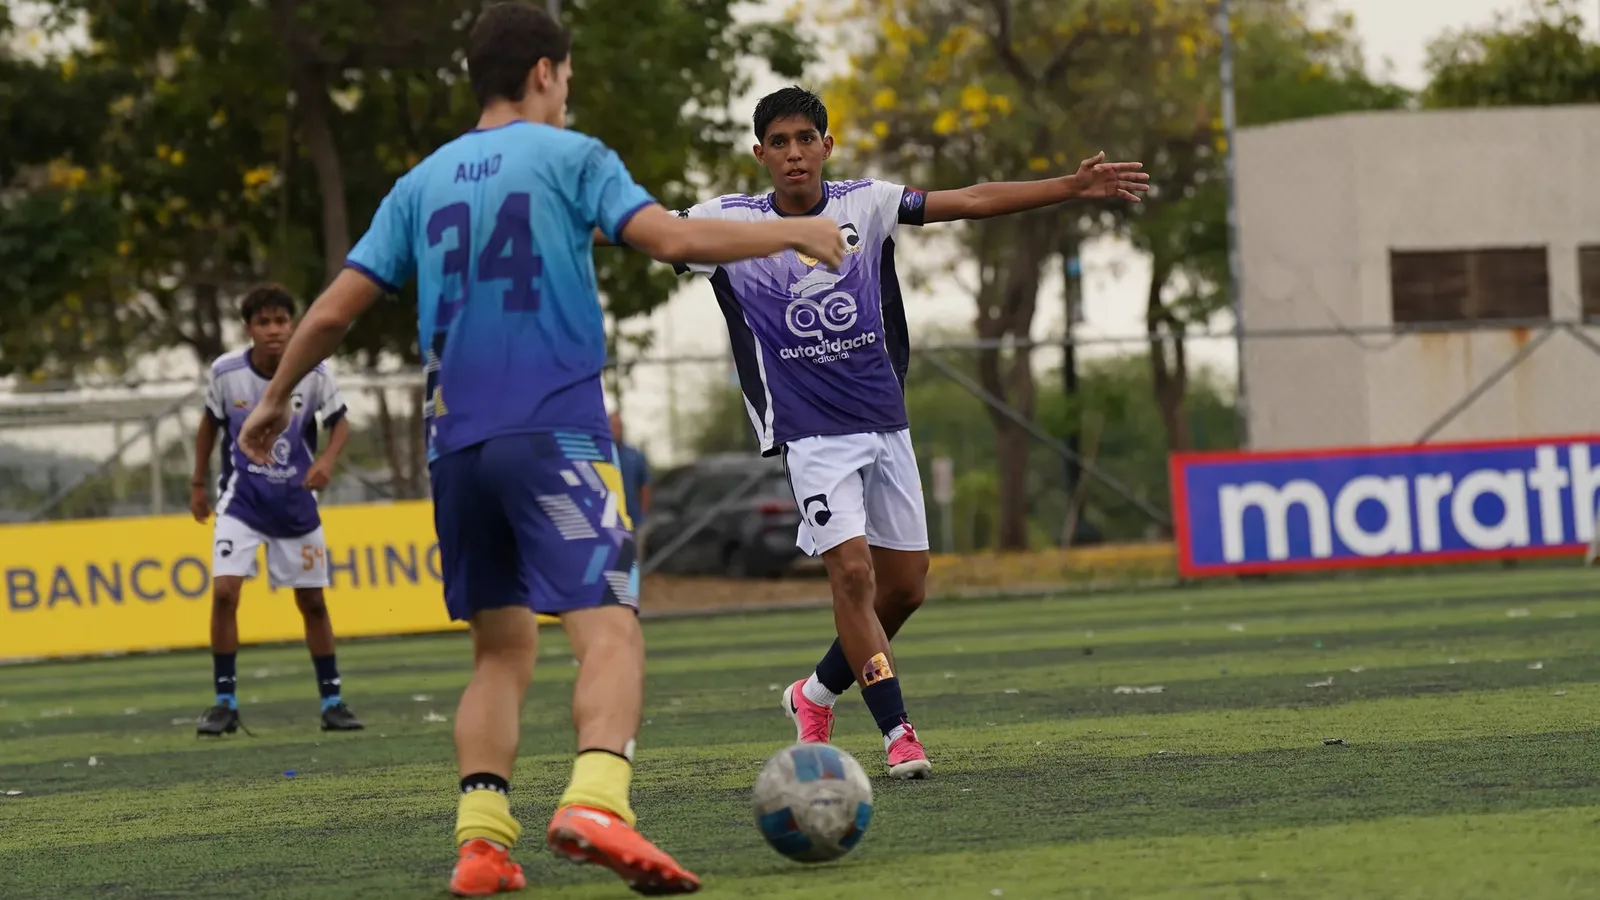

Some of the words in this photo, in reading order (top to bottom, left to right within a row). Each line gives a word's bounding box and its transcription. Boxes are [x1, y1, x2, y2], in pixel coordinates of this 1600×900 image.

[426, 192, 543, 328] 34
[779, 331, 876, 360] autodidacto
[812, 351, 850, 364] editorial
[1218, 443, 1600, 564] marath
[301, 544, 325, 572] 54
[6, 555, 210, 612] BANCO
